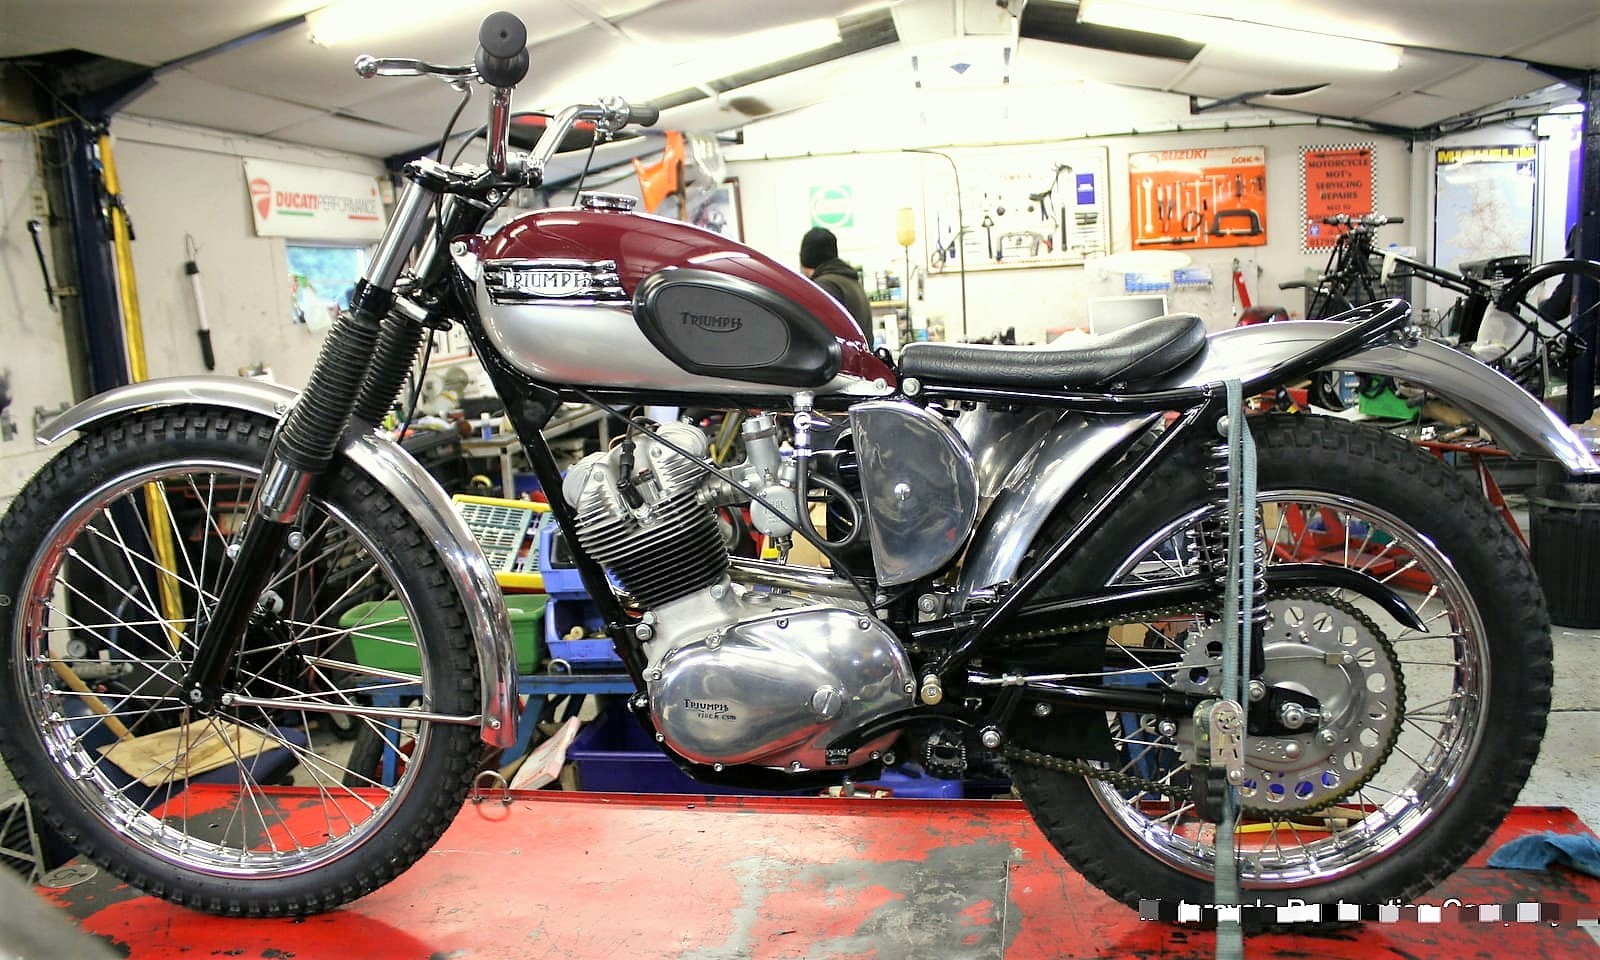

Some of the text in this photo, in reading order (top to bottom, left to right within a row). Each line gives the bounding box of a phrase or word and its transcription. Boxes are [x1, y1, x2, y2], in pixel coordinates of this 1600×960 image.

[1161, 149, 1208, 160] SUZUKI
[1309, 158, 1368, 168] MOTORCYCLE
[1316, 181, 1362, 190] SERVICING
[275, 191, 317, 209] DUCATI
[1321, 192, 1358, 200] REPAIRS
[501, 266, 593, 288] TRIUMPH
[680, 311, 743, 330] TRIUMPH
[683, 698, 729, 712] TRIUMPH
